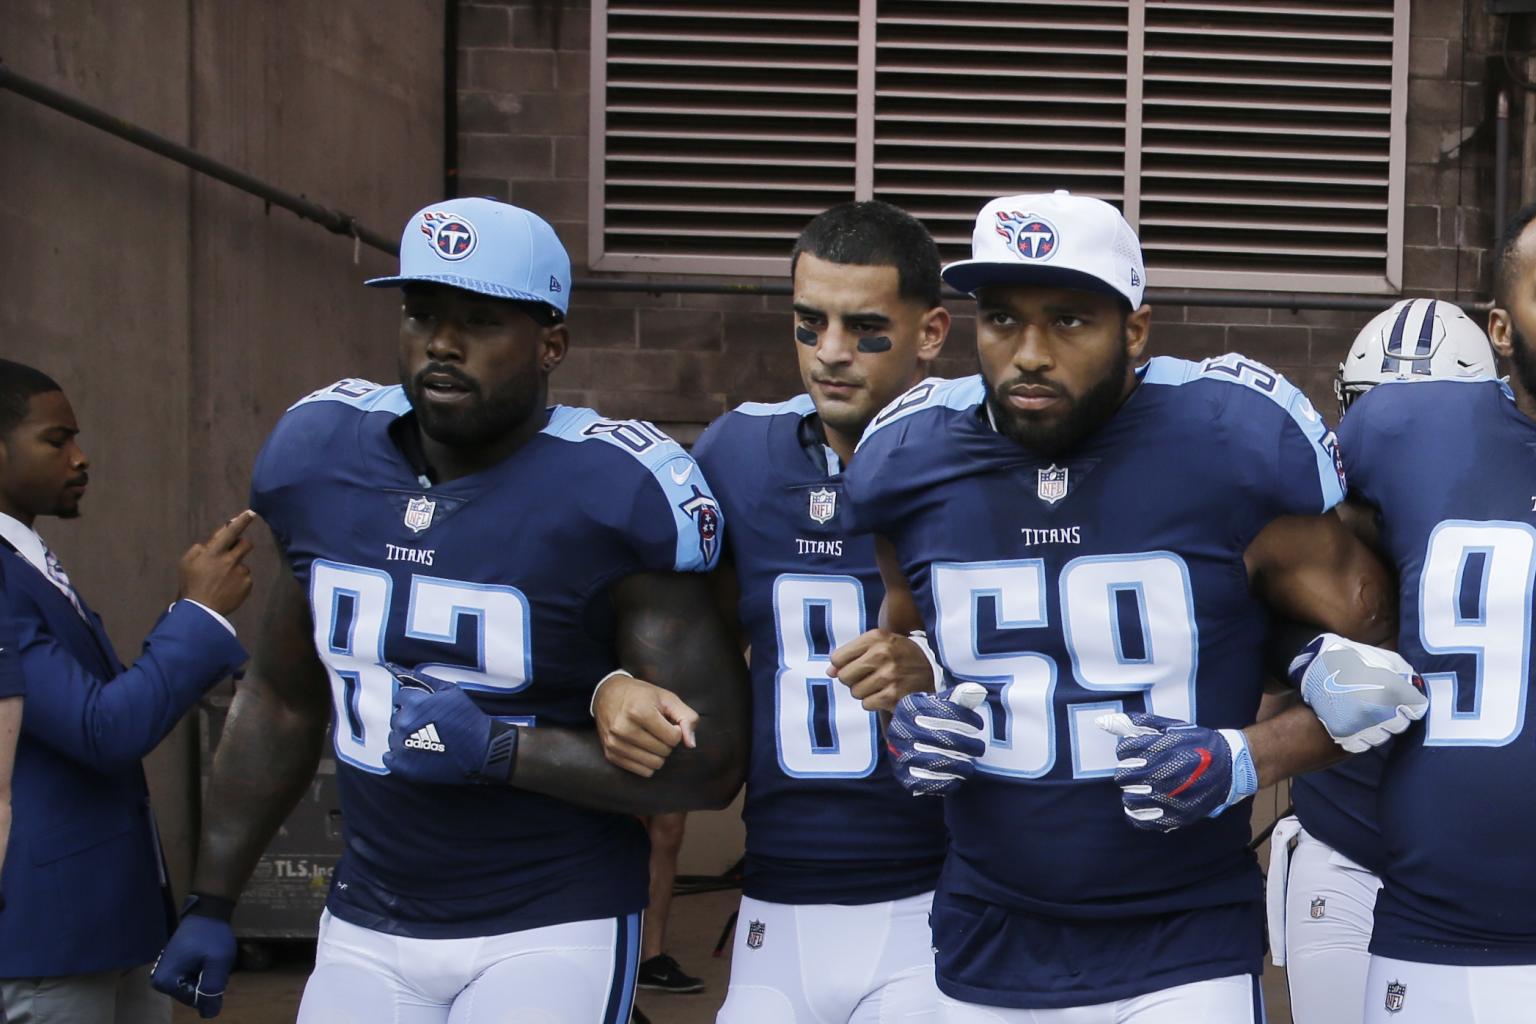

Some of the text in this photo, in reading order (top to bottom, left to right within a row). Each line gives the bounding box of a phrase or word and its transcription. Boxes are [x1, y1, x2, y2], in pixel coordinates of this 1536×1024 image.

[795, 538, 843, 557] TITANS
[1021, 526, 1081, 546] TITANS
[385, 543, 436, 566] TITANS
[310, 557, 536, 776] 82
[772, 572, 879, 779] 8
[930, 550, 1199, 780] 59
[404, 739, 446, 752] adidas
